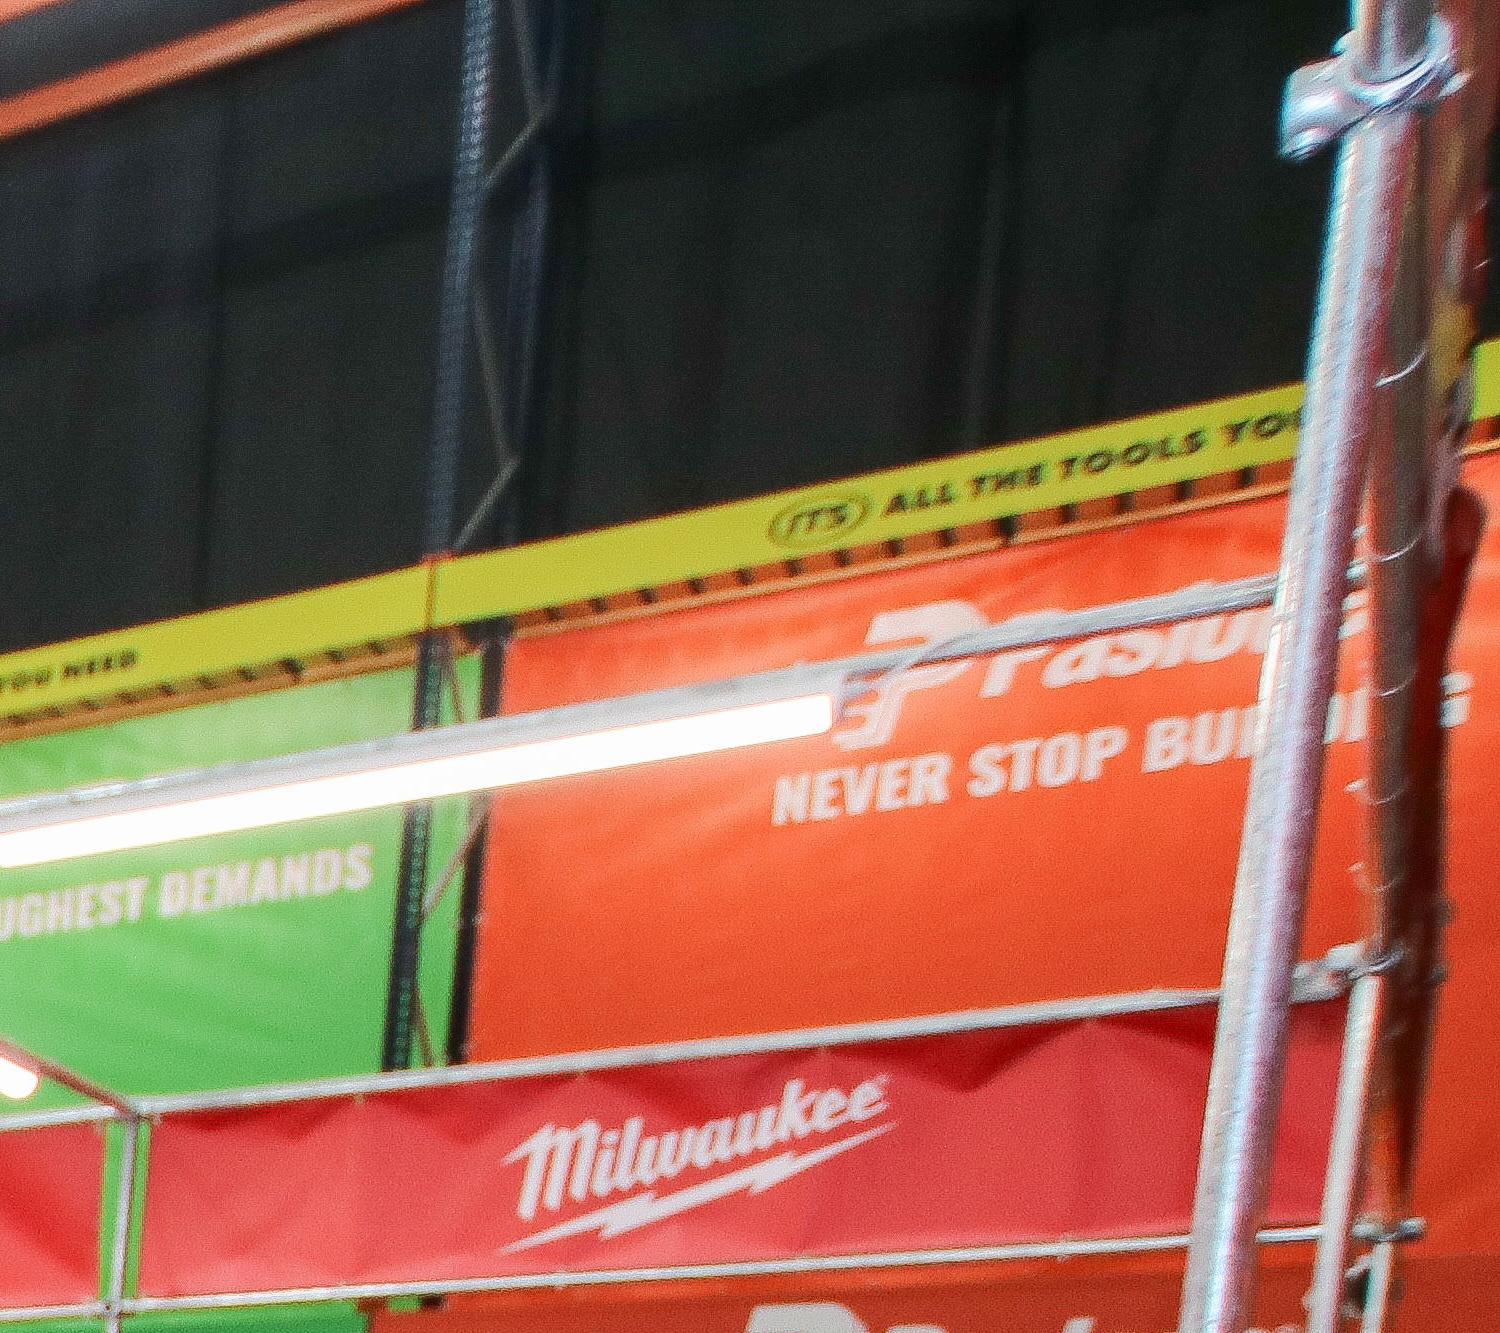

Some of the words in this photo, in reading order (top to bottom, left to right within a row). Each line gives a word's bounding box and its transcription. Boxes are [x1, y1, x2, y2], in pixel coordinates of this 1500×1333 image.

[785, 500, 850, 539] ITS
[881, 481, 957, 519] ALL
[969, 460, 1045, 498] THE
[1057, 429, 1210, 477] TOOLS
[770, 752, 956, 827] NEVER
[965, 722, 1129, 800] STOP
[153, 841, 376, 918] DEMANDS
[501, 1073, 891, 1222] Milwaukee
